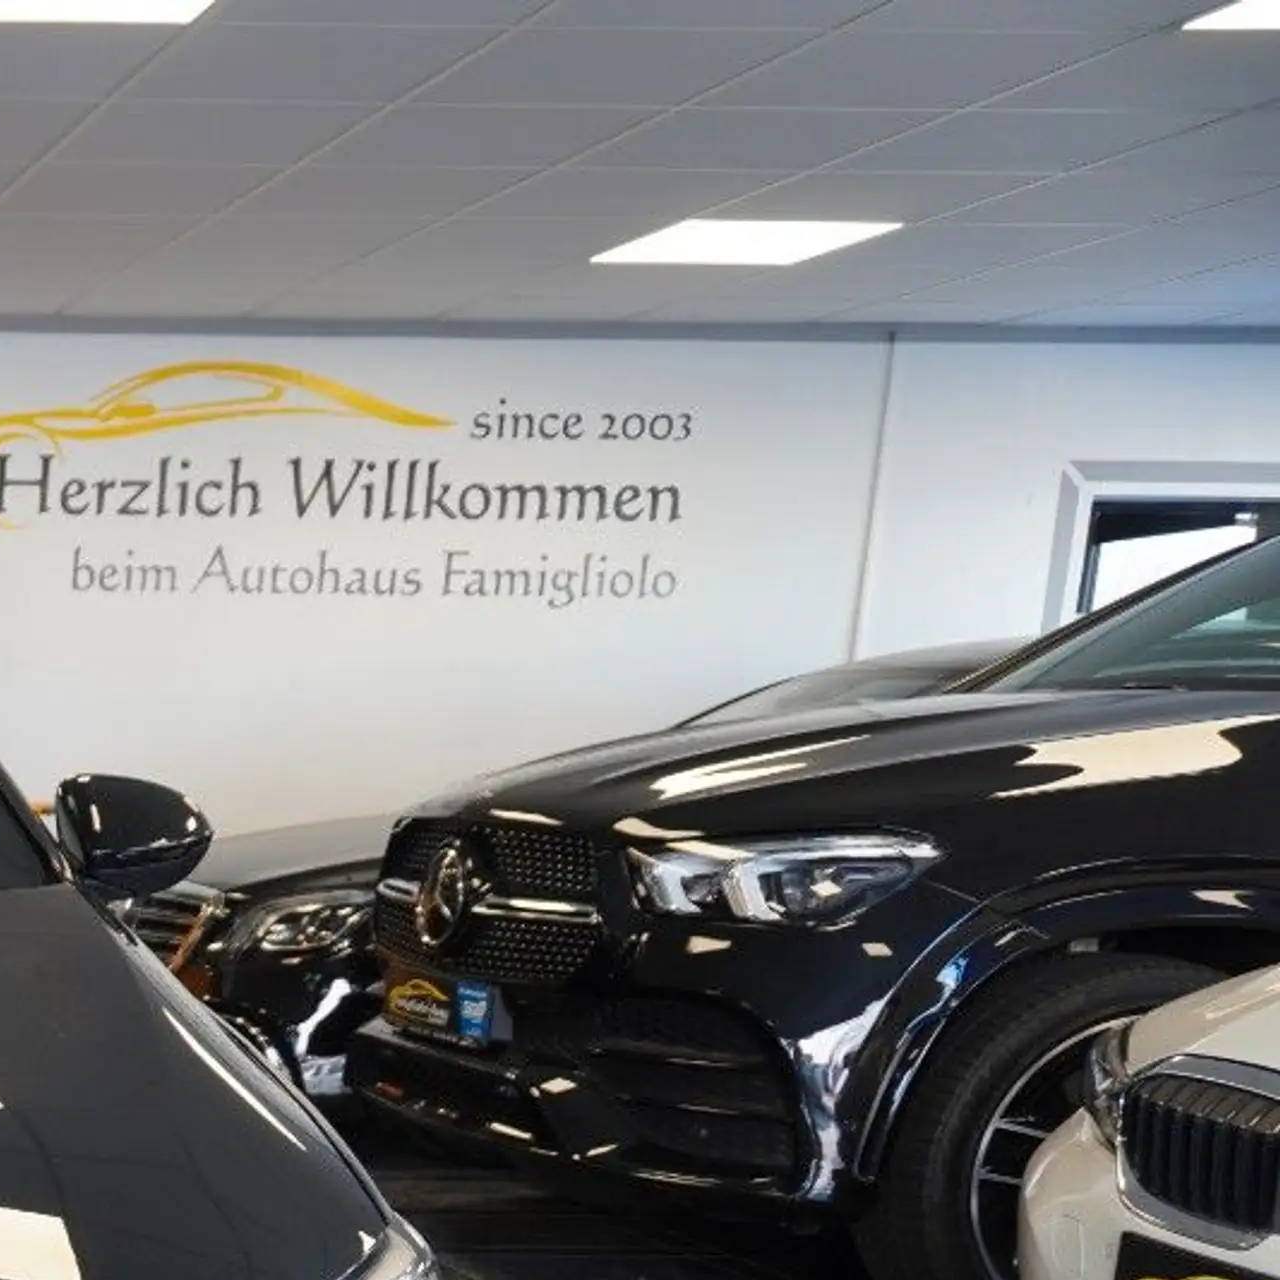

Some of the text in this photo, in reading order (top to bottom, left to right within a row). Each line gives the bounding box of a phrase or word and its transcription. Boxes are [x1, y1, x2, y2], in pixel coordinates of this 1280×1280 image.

[469, 397, 693, 443] since 2003
[286, 456, 683, 523] Willkommen
[71, 544, 678, 610] beim Autohaus Famigliolo
